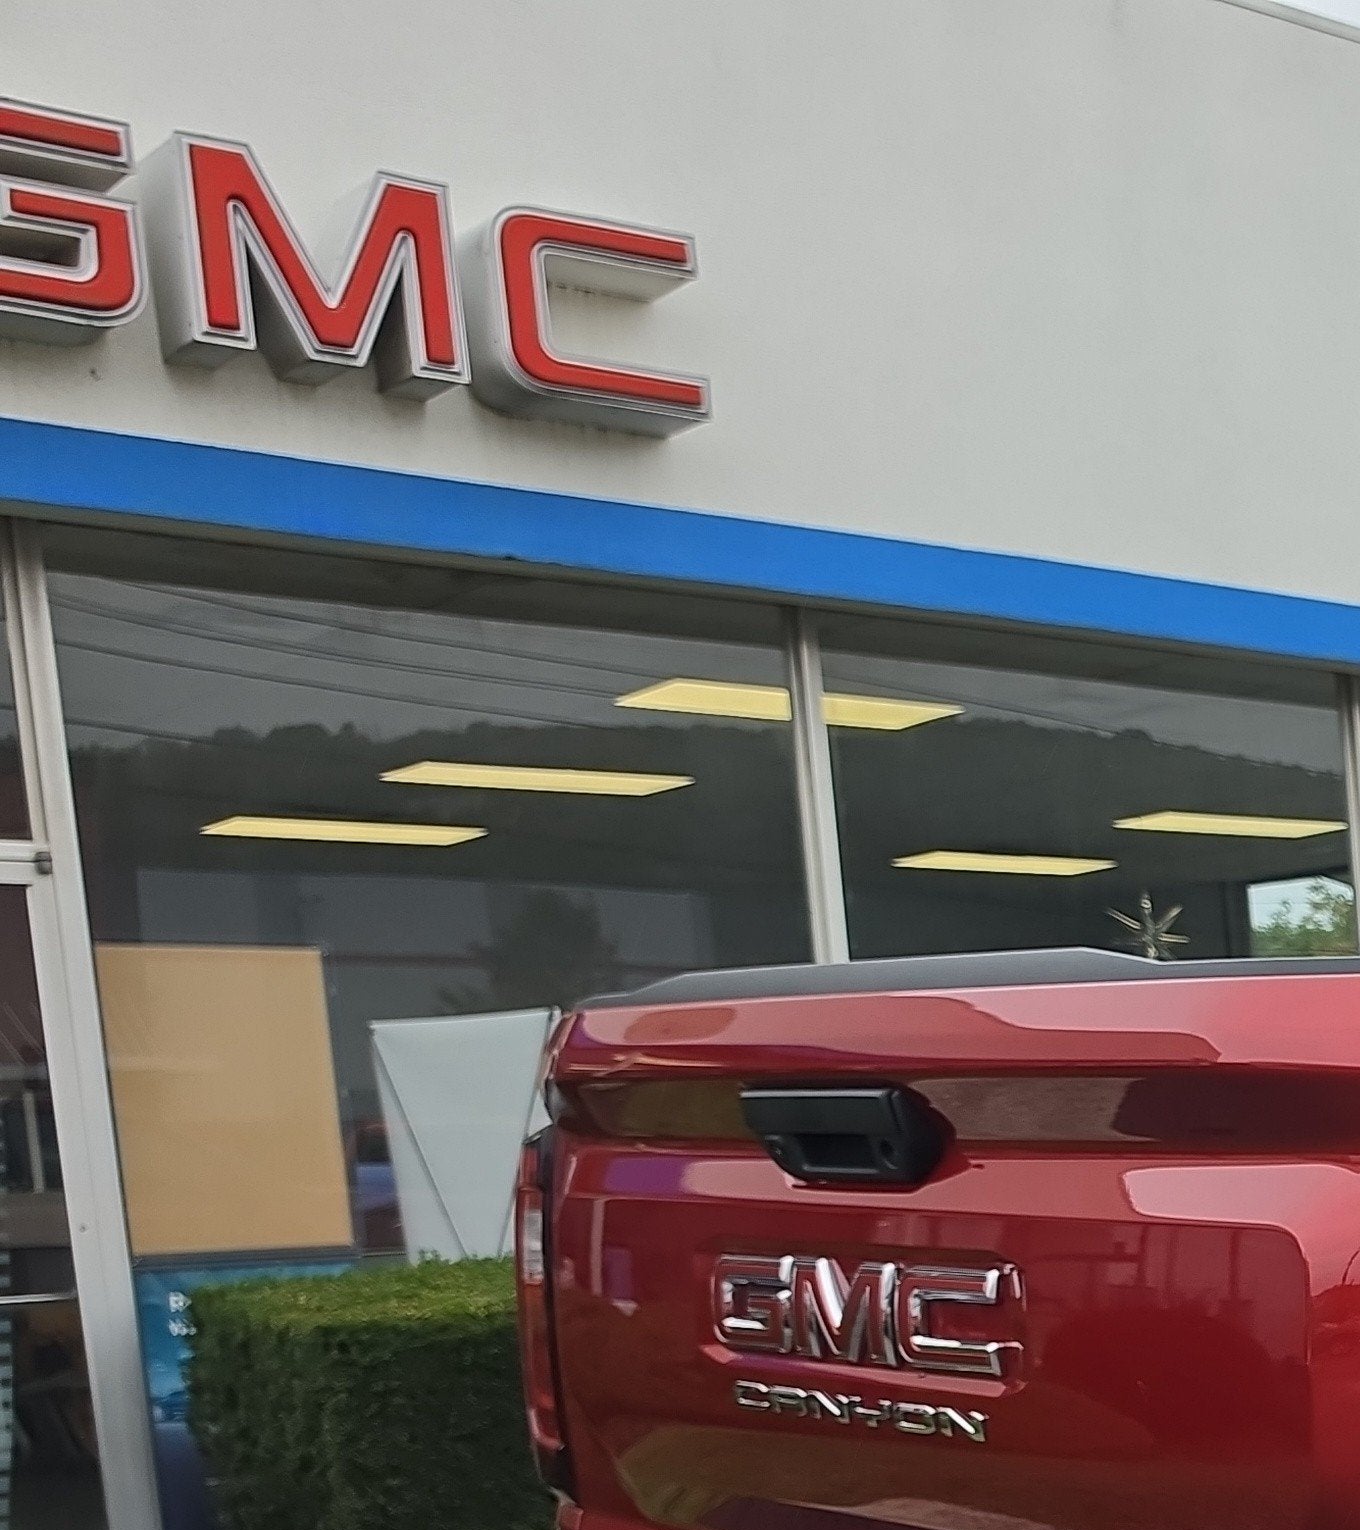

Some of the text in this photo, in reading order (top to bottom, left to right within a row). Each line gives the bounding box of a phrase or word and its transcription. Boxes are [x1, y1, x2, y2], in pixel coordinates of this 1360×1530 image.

[0, 98, 712, 438] GMC
[711, 1254, 1027, 1375] GMC
[735, 1379, 989, 1443] CANYON
